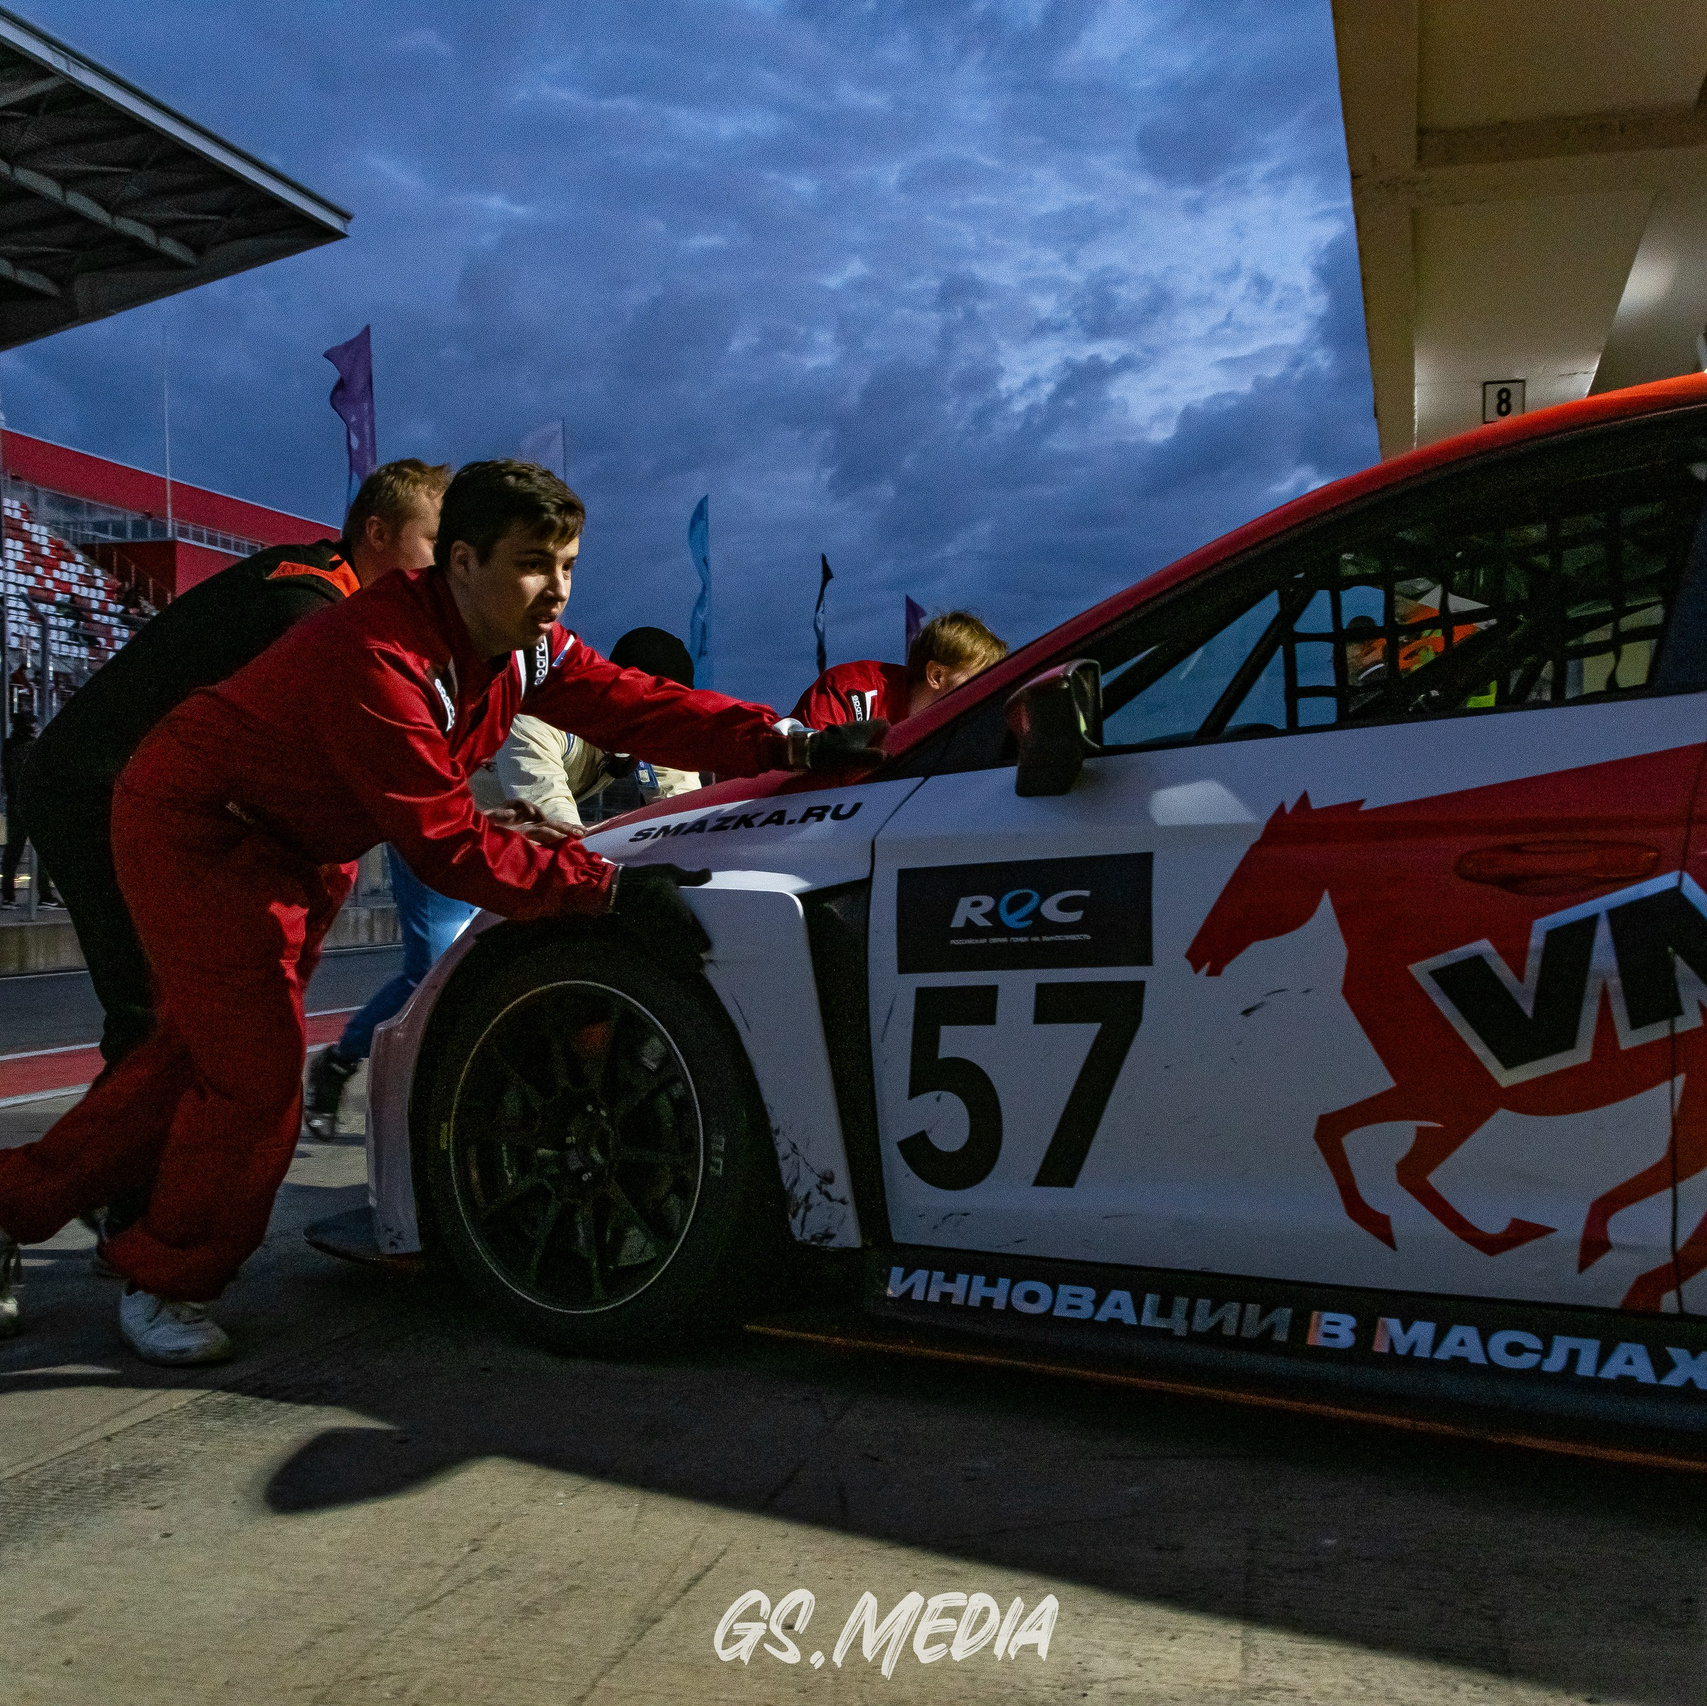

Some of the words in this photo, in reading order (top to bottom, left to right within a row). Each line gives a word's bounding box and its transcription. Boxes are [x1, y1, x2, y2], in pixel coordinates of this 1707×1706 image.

[1497, 387, 1511, 416] 8
[533, 638, 549, 686] sparc
[628, 802, 863, 843] SMAZKA.RU
[896, 980, 1147, 1192] 57
[886, 1265, 1293, 1343] ИННОВАЦИИ
[1306, 1310, 1357, 1350] В
[1371, 1316, 1707, 1390] МАСЛАХ
